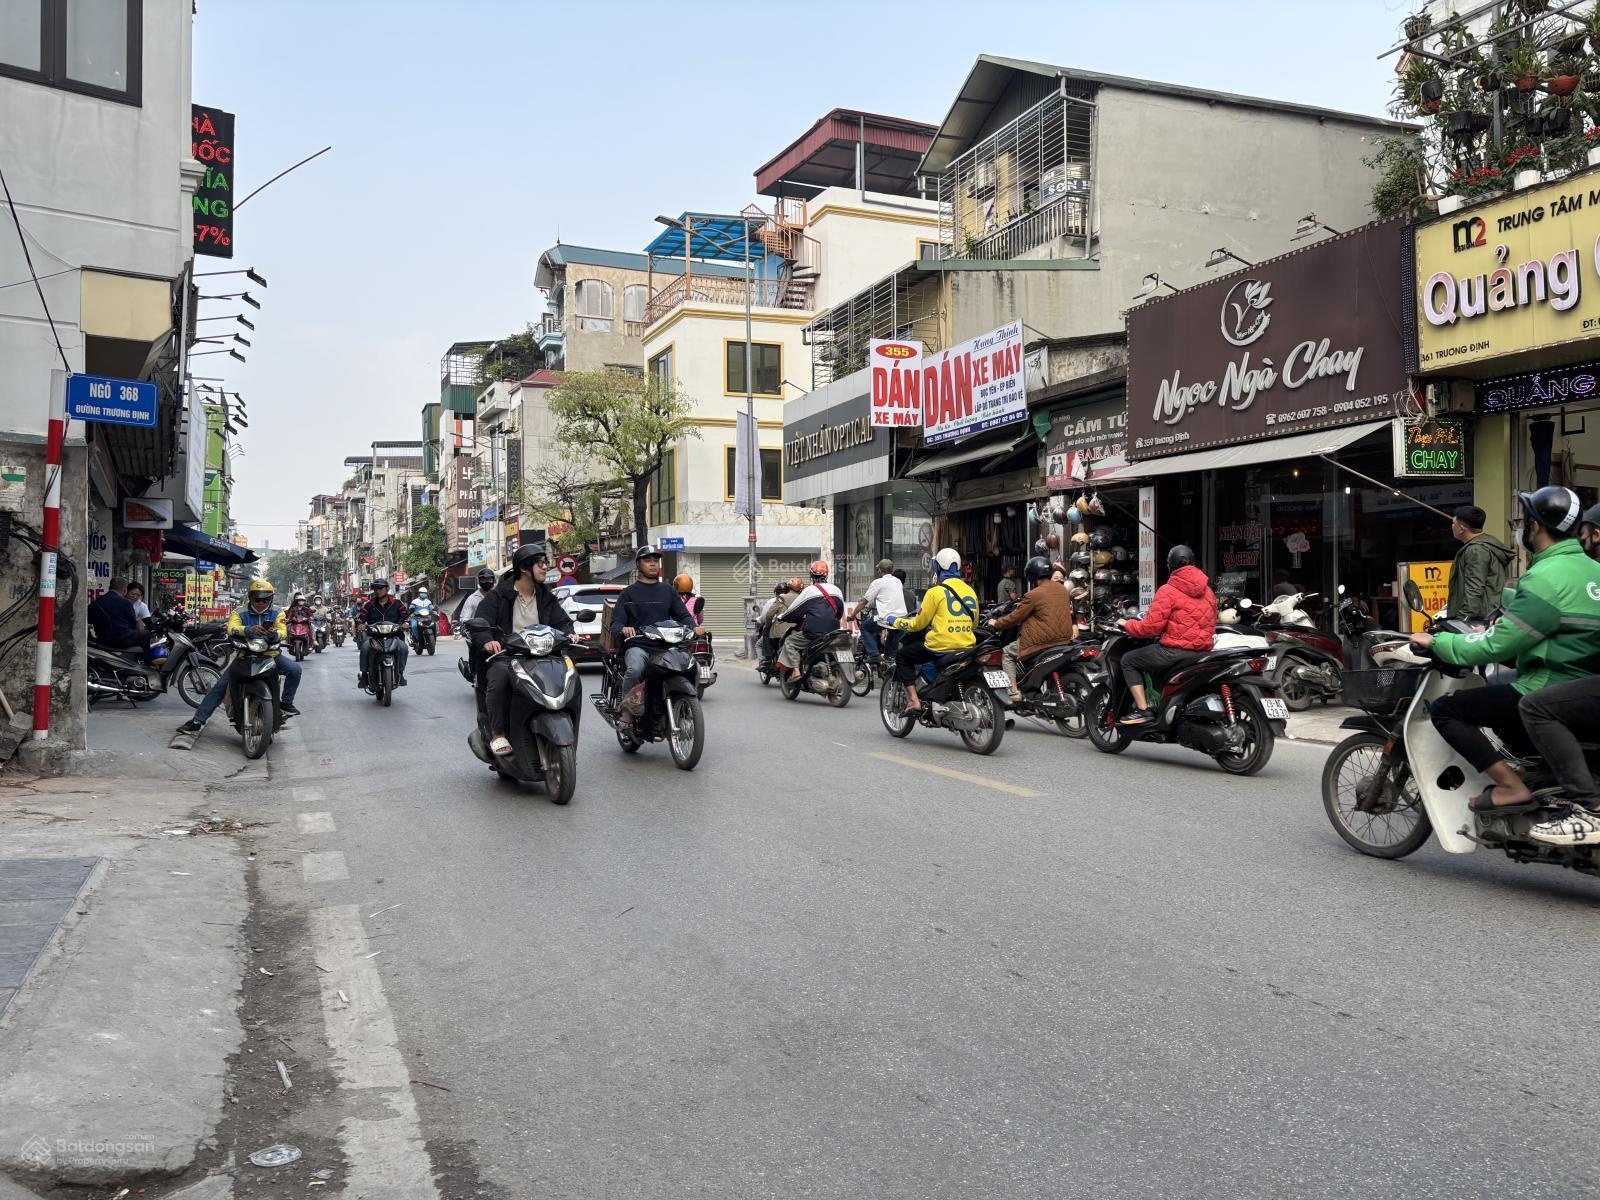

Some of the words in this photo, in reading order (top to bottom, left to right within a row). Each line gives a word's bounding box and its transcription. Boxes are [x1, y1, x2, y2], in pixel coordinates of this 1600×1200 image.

[1497, 207, 1544, 233] TRUNG
[1550, 195, 1583, 217] TÂM
[1423, 244, 1580, 327] Quảng
[885, 347, 910, 357] 355
[972, 355, 989, 388] XE
[992, 340, 1022, 380] MÁY
[89, 382, 111, 399] NGÕ
[120, 386, 139, 402] 368
[873, 360, 920, 409] DÁN
[923, 350, 973, 429] DÁN
[1152, 369, 1217, 425] Ngọc
[1218, 351, 1279, 411] Ngà
[1282, 338, 1364, 391] Chay
[1485, 375, 1597, 407] QUẢNG
[75, 403, 101, 416] ĐƯỜNG
[102, 407, 131, 418] TRƯƠNG
[132, 410, 150, 421] ĐỊNH
[874, 412, 890, 425] XE
[893, 410, 919, 426] MÁY
[1278, 411, 1296, 423] 0962
[1312, 406, 1328, 417] 758
[1333, 401, 1354, 414] 0904
[1373, 394, 1388, 405] 195
[832, 415, 873, 452] OPTICAL
[1063, 416, 1102, 437] CẨM
[1411, 450, 1459, 469] CHAY
[944, 589, 977, 616] be
